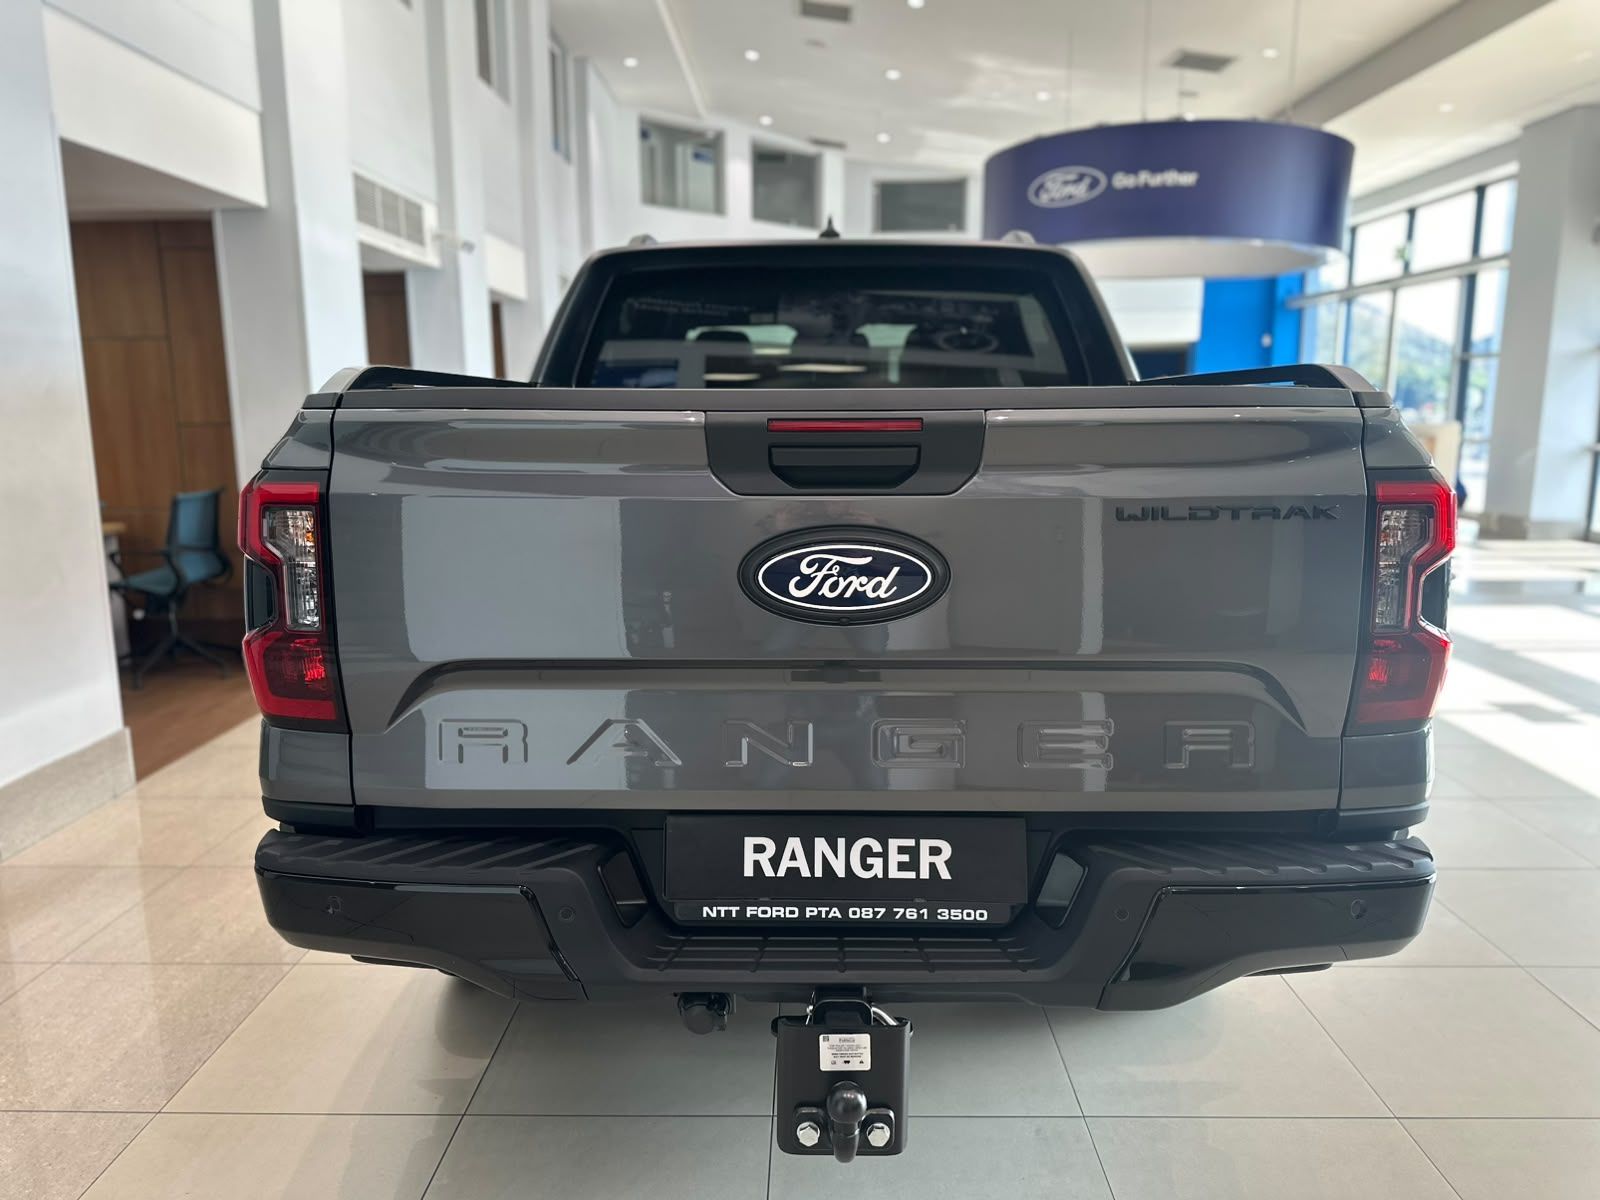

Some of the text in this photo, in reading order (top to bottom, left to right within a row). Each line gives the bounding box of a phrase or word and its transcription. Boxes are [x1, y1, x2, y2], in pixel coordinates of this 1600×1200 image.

[1112, 171, 1136, 190] Go
[1137, 169, 1198, 188] Further
[1115, 505, 1339, 522] WILDTRAK
[788, 553, 901, 599] Ford
[438, 718, 1257, 770] RANGER
[742, 835, 953, 881] RANGER
[702, 905, 988, 922] NTT FORD PTA 087 761 3500
